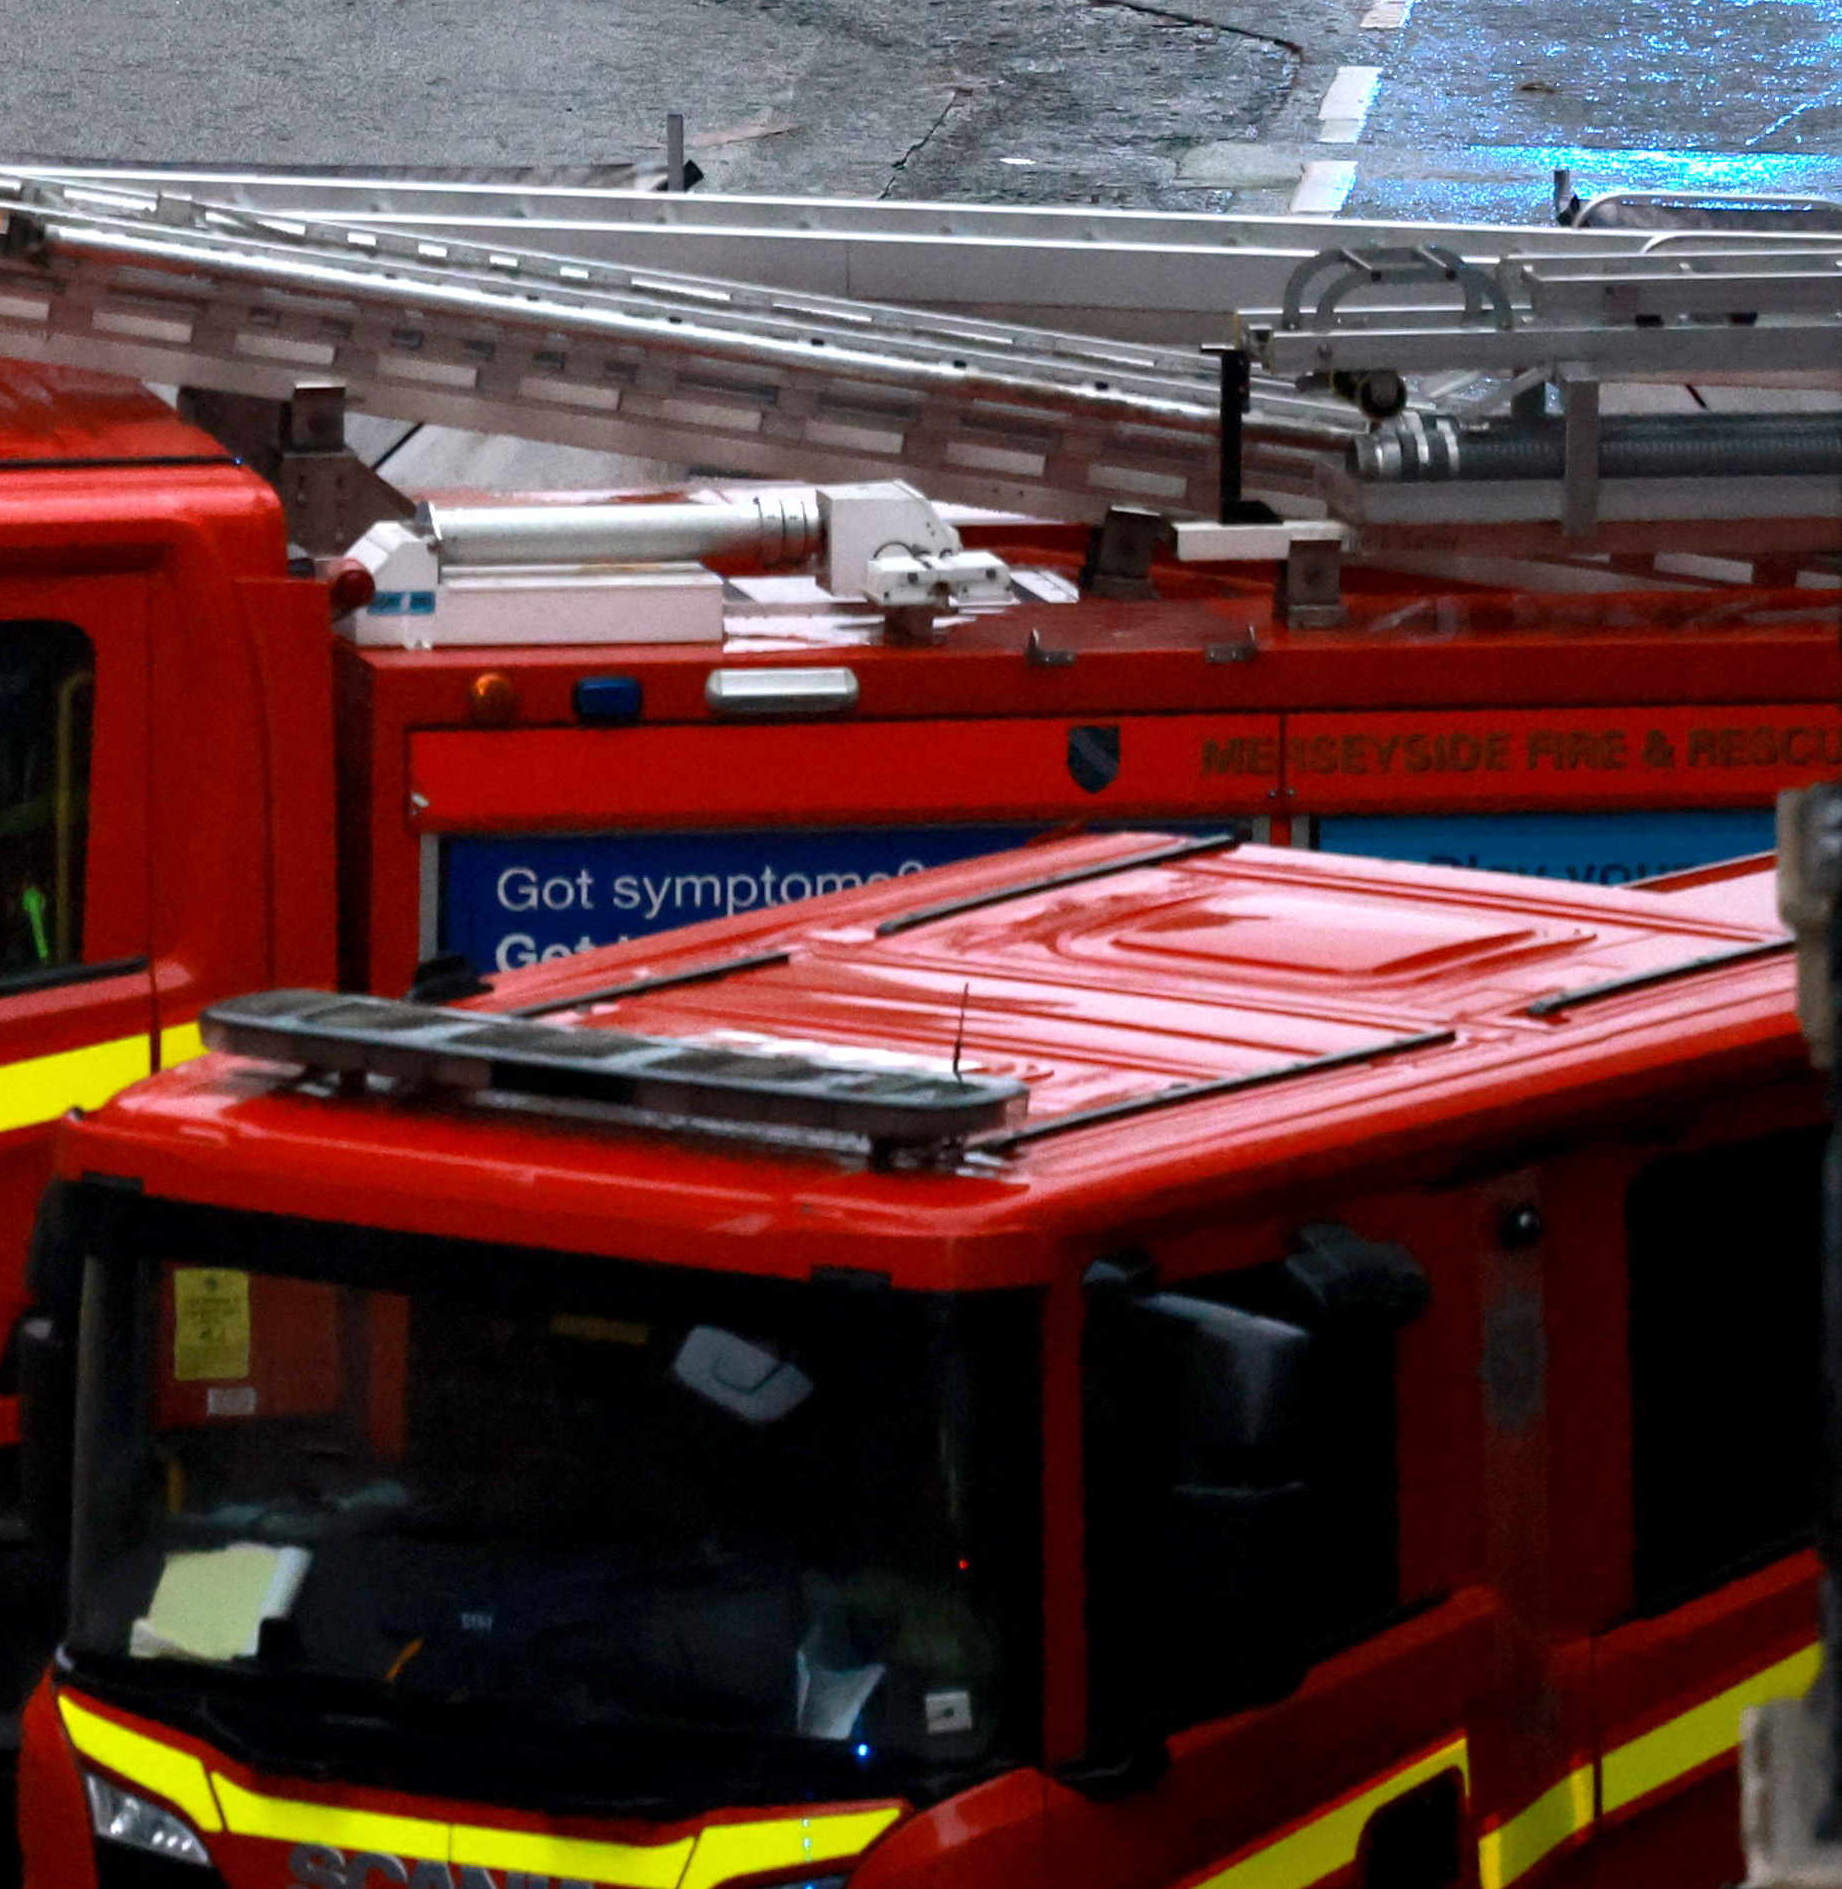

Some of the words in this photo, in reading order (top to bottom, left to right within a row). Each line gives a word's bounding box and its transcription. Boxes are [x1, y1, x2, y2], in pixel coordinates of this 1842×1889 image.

[1201, 731, 1511, 775] MERSEYSIDE
[1527, 729, 1627, 770] FIRE
[1642, 728, 1674, 768] &
[497, 867, 594, 911] Got
[613, 860, 925, 919] symptom
